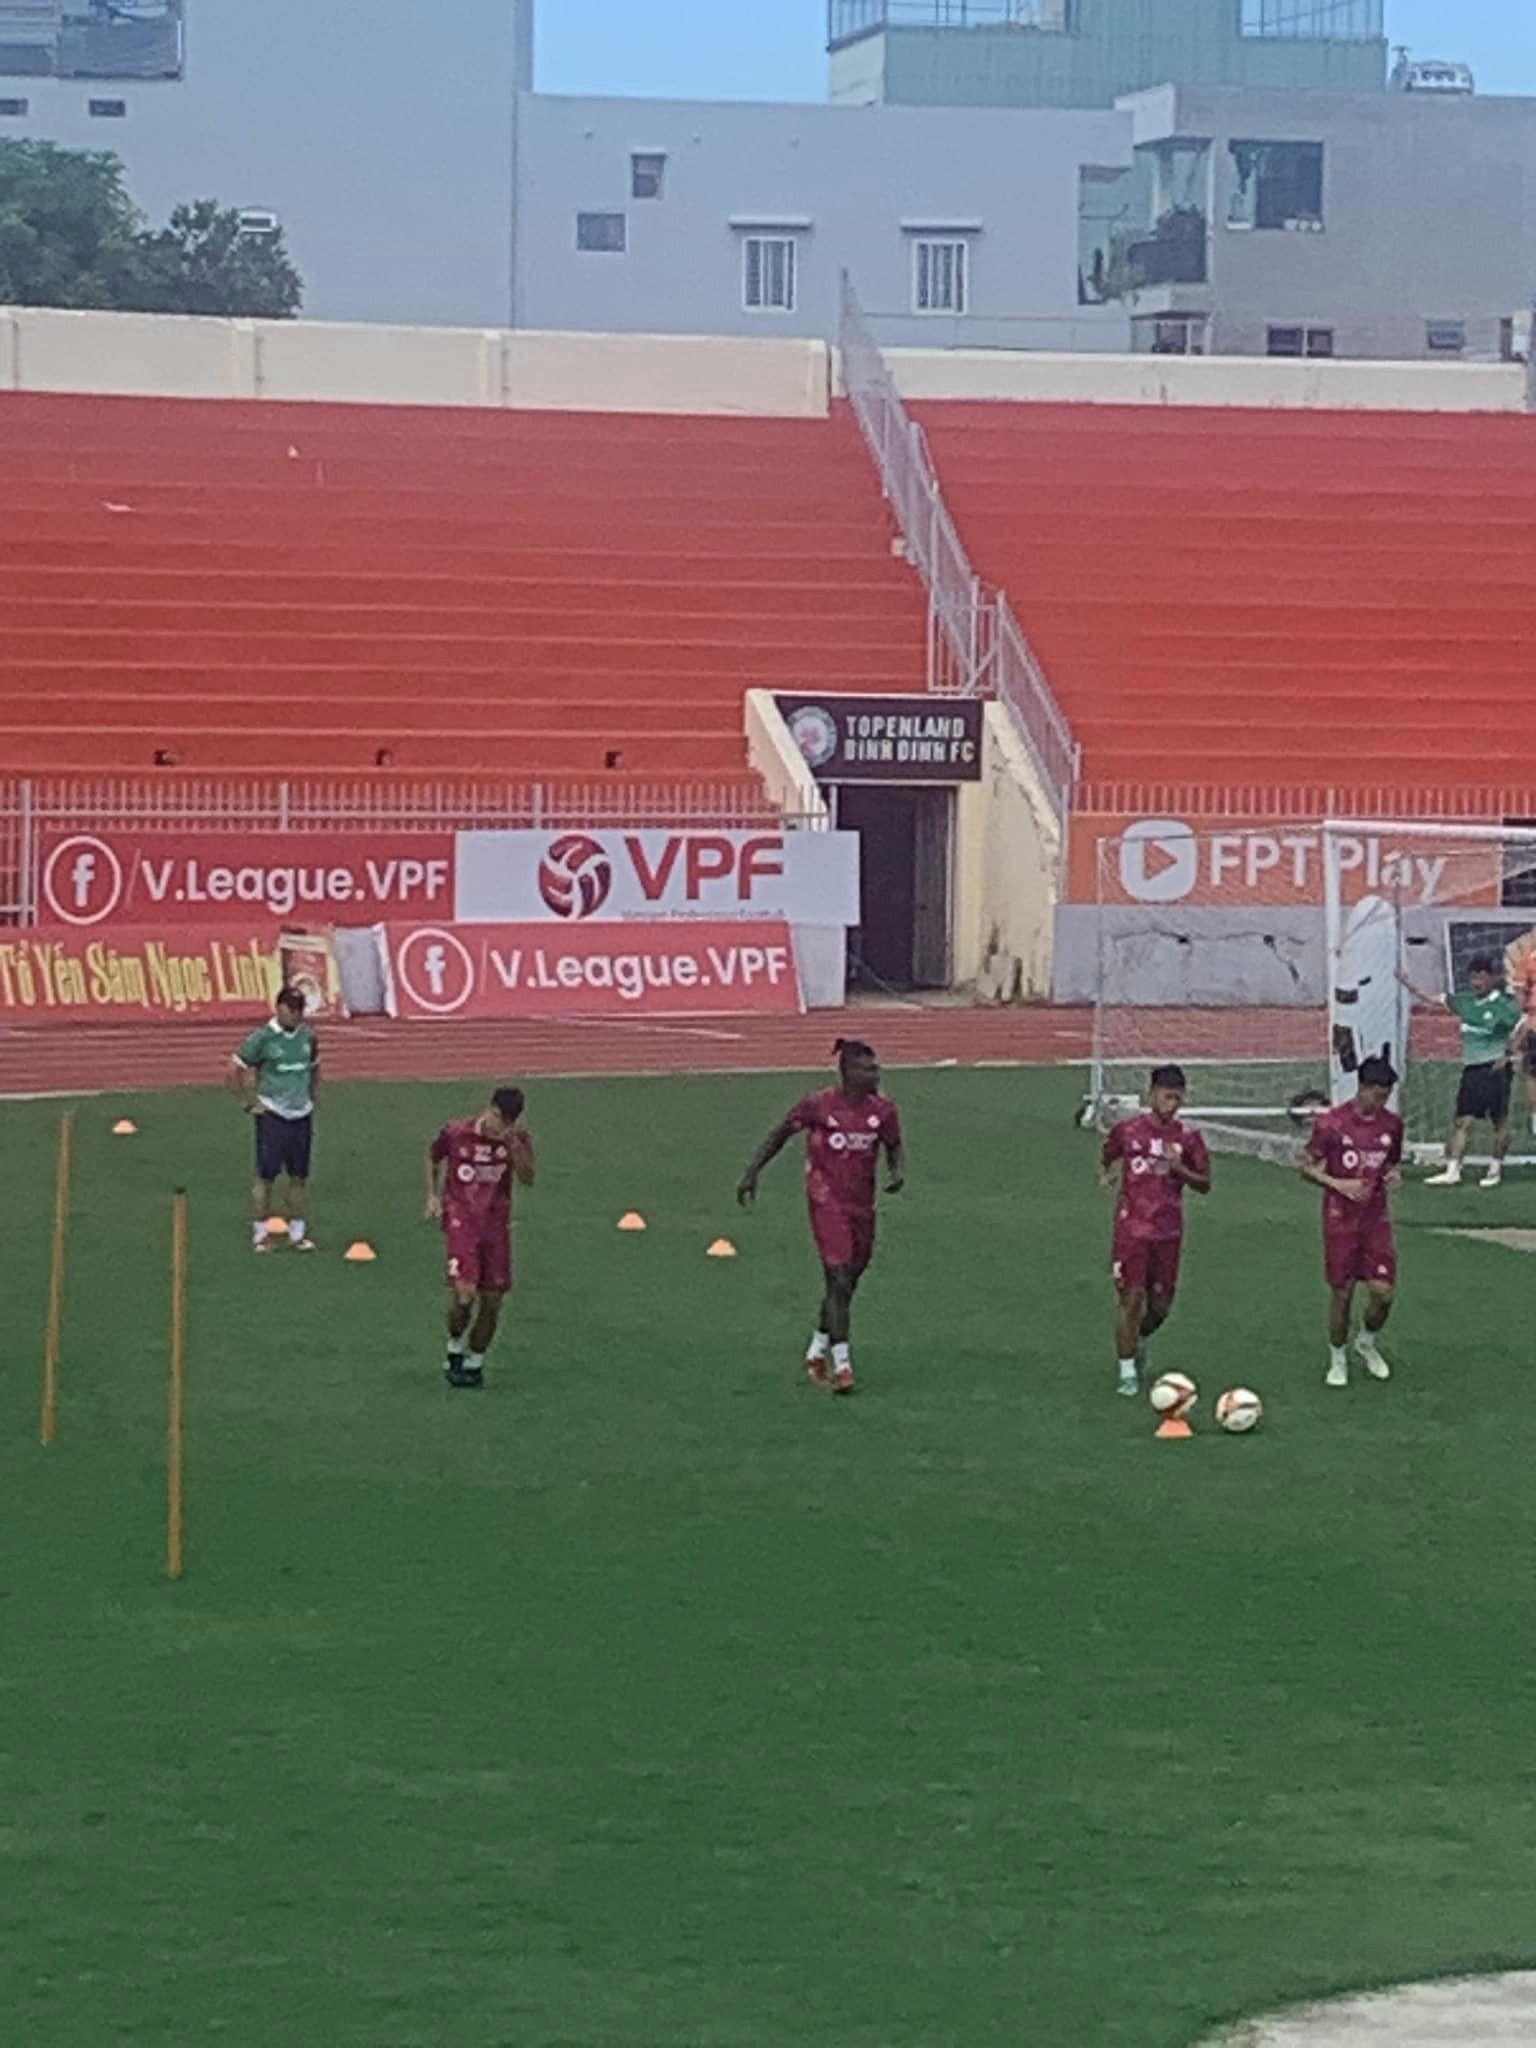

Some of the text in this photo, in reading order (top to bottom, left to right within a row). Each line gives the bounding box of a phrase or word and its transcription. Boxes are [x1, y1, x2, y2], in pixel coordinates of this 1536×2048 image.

[845, 715, 965, 739] TOPENLAND
[950, 741, 975, 763] FC
[625, 836, 785, 901] VPF
[1210, 836, 1449, 904] FPT Play
